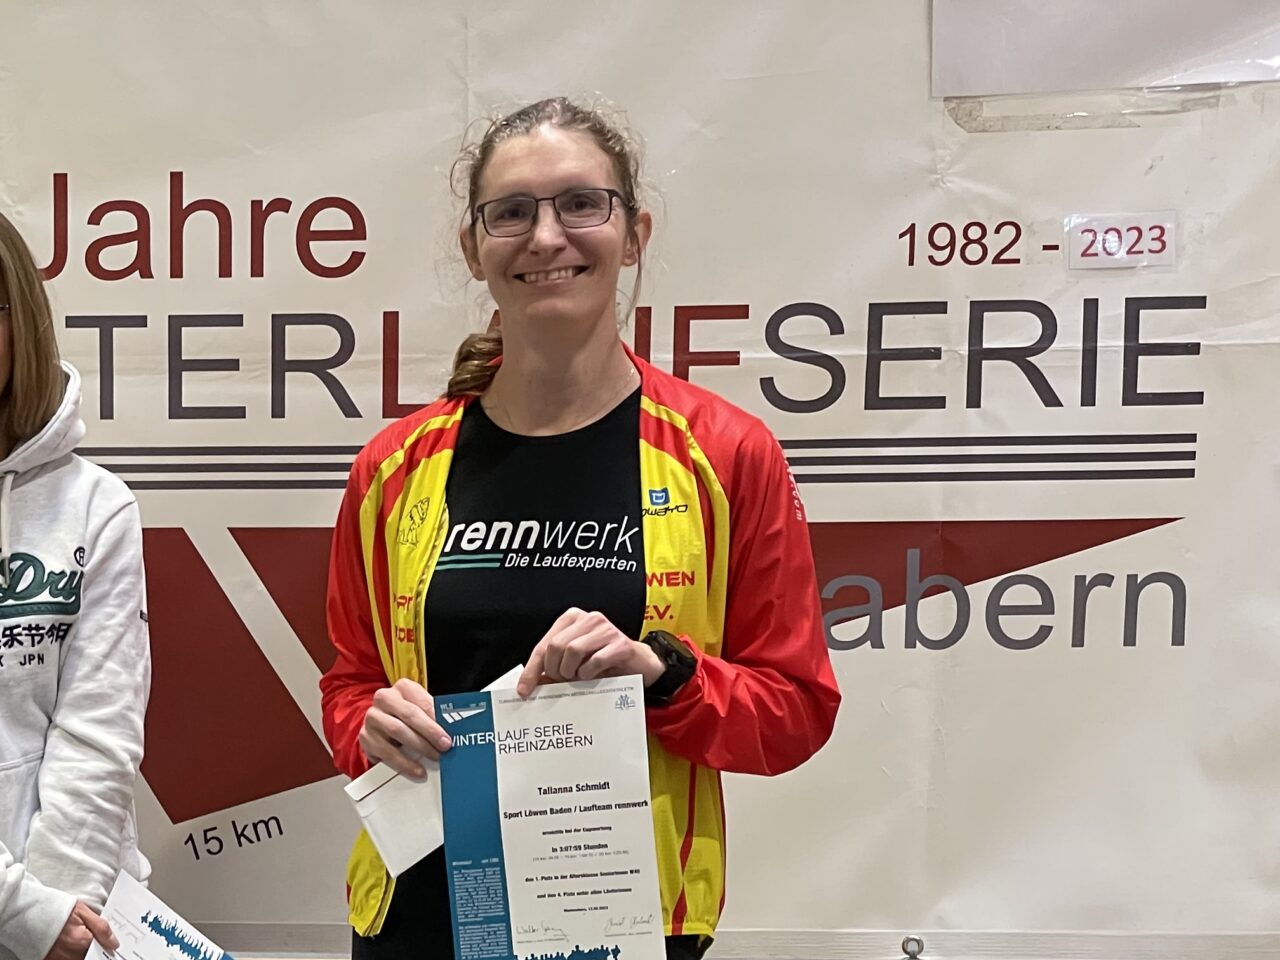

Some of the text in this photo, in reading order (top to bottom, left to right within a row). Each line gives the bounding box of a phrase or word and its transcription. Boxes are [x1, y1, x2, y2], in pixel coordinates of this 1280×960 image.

[37, 171, 368, 281] Jahre
[899, 219, 1023, 267] 1982
[1078, 223, 1169, 260] 2023
[443, 516, 640, 554] rennwerk
[504, 551, 637, 573] Die Laufexperten
[646, 570, 695, 588] WEN
[821, 549, 1188, 652] abern
[19, 653, 45, 667] JPN
[497, 728, 530, 742] LAUF
[534, 723, 574, 738] SERIE
[499, 735, 593, 755] RHEINZABERN
[575, 781, 610, 793] Schmidt
[503, 811, 523, 820] Sport
[524, 809, 548, 817] Löwen
[549, 807, 572, 815] Baden
[579, 803, 613, 813] Laufteam
[614, 799, 648, 809] rennwerk
[183, 815, 284, 861] 15 km
